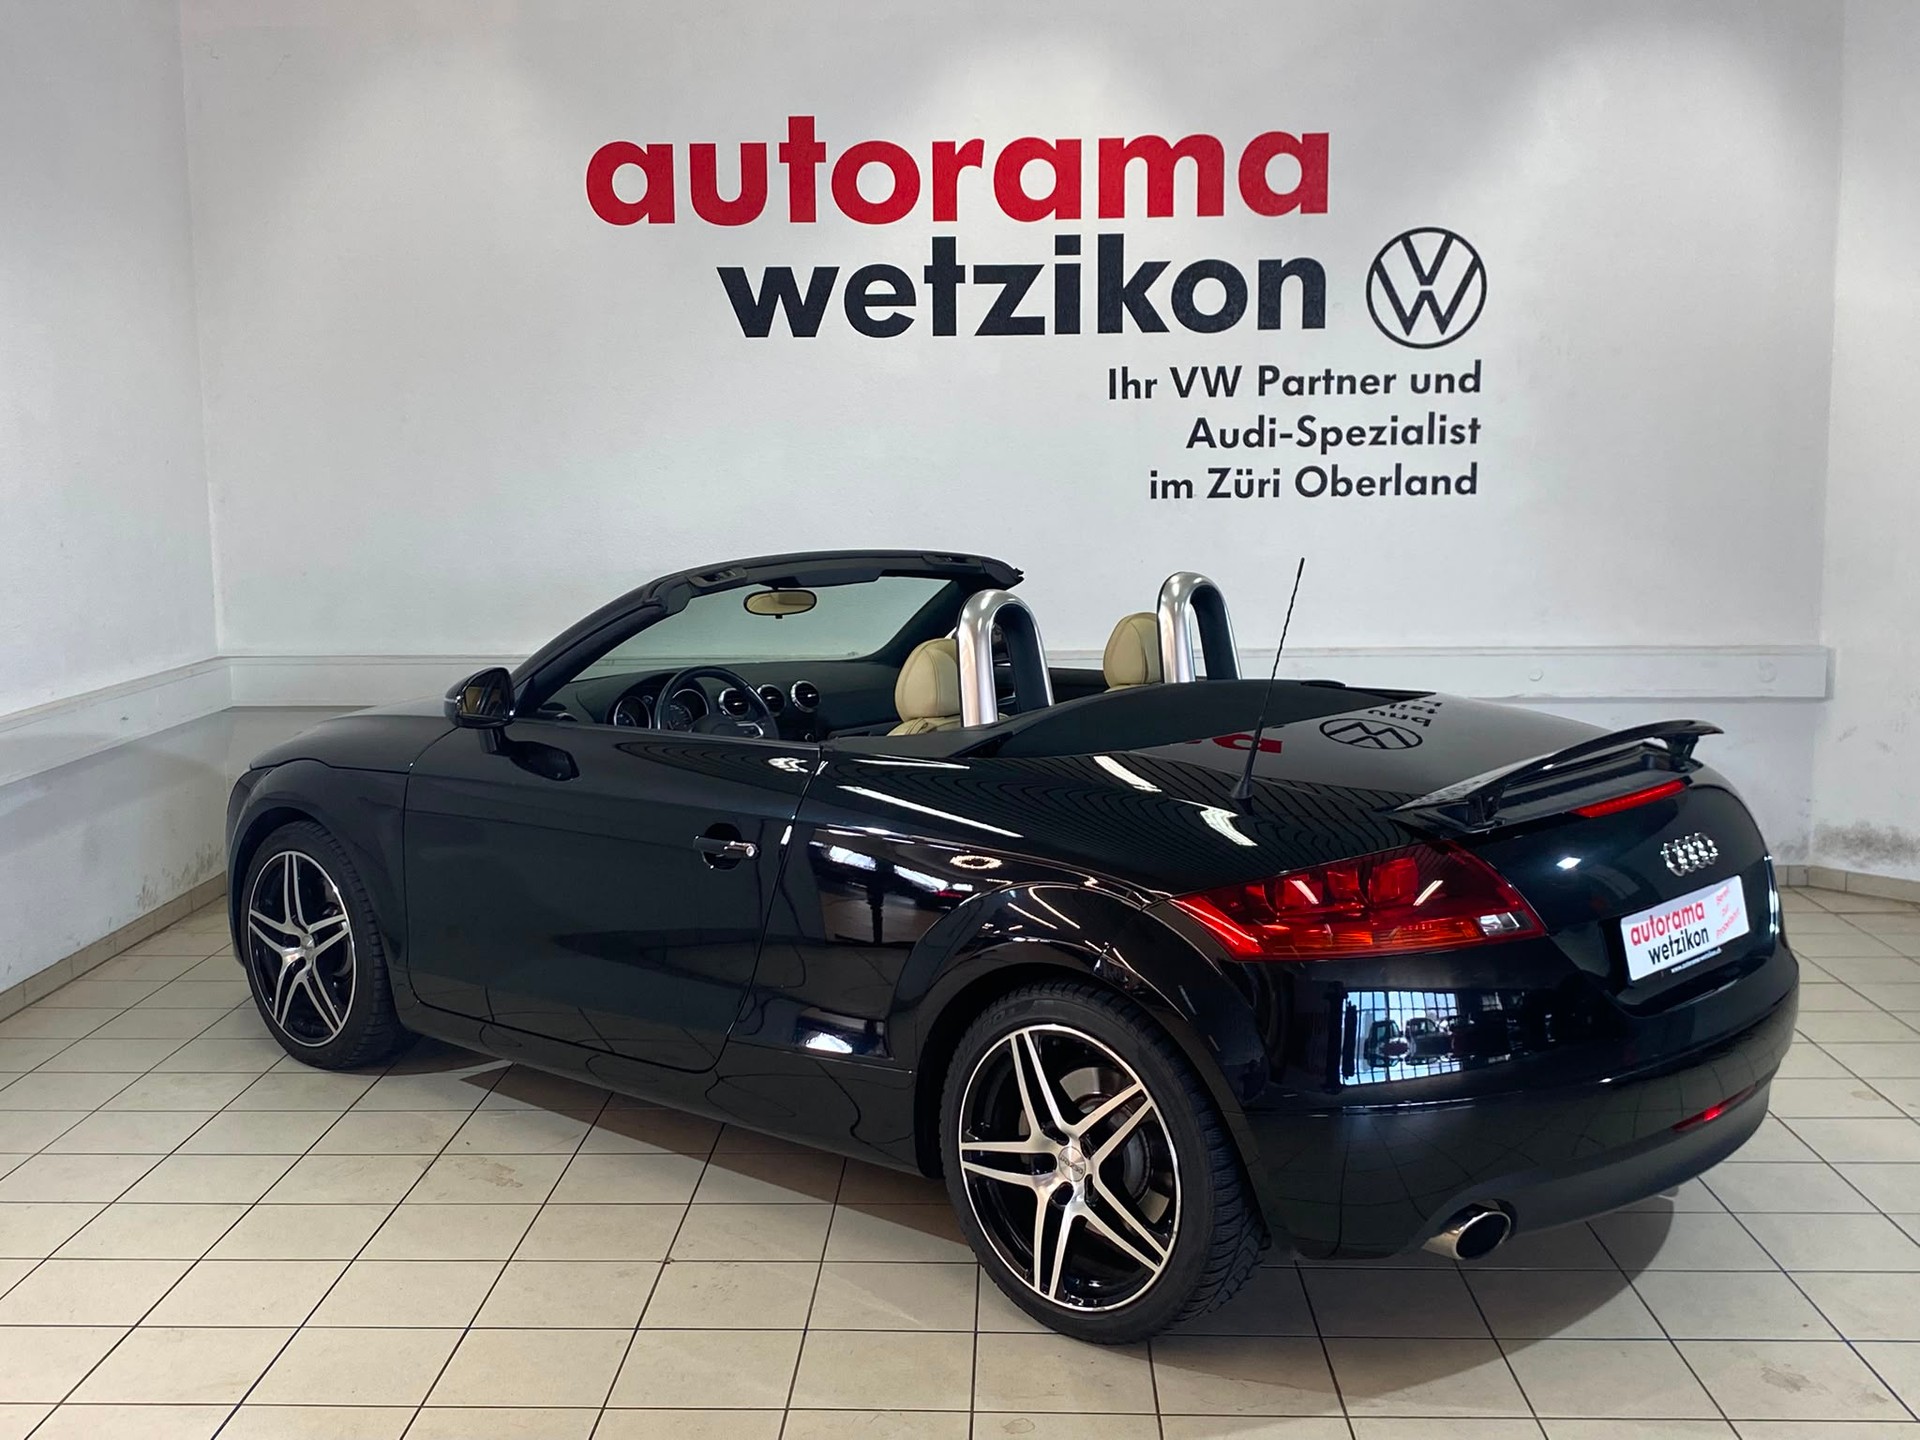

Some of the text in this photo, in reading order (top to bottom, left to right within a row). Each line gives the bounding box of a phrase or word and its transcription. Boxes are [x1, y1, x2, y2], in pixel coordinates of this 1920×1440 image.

[586, 116, 1328, 226] autorama
[717, 234, 1326, 338] wetzikon
[1109, 360, 1482, 400] Ihr VW Partner und
[1185, 411, 1481, 455] Audi-Spezialist
[1150, 462, 1478, 500] im Züri Oberland
[1630, 902, 1705, 946] autorama
[1648, 927, 1709, 966] wetzikon
